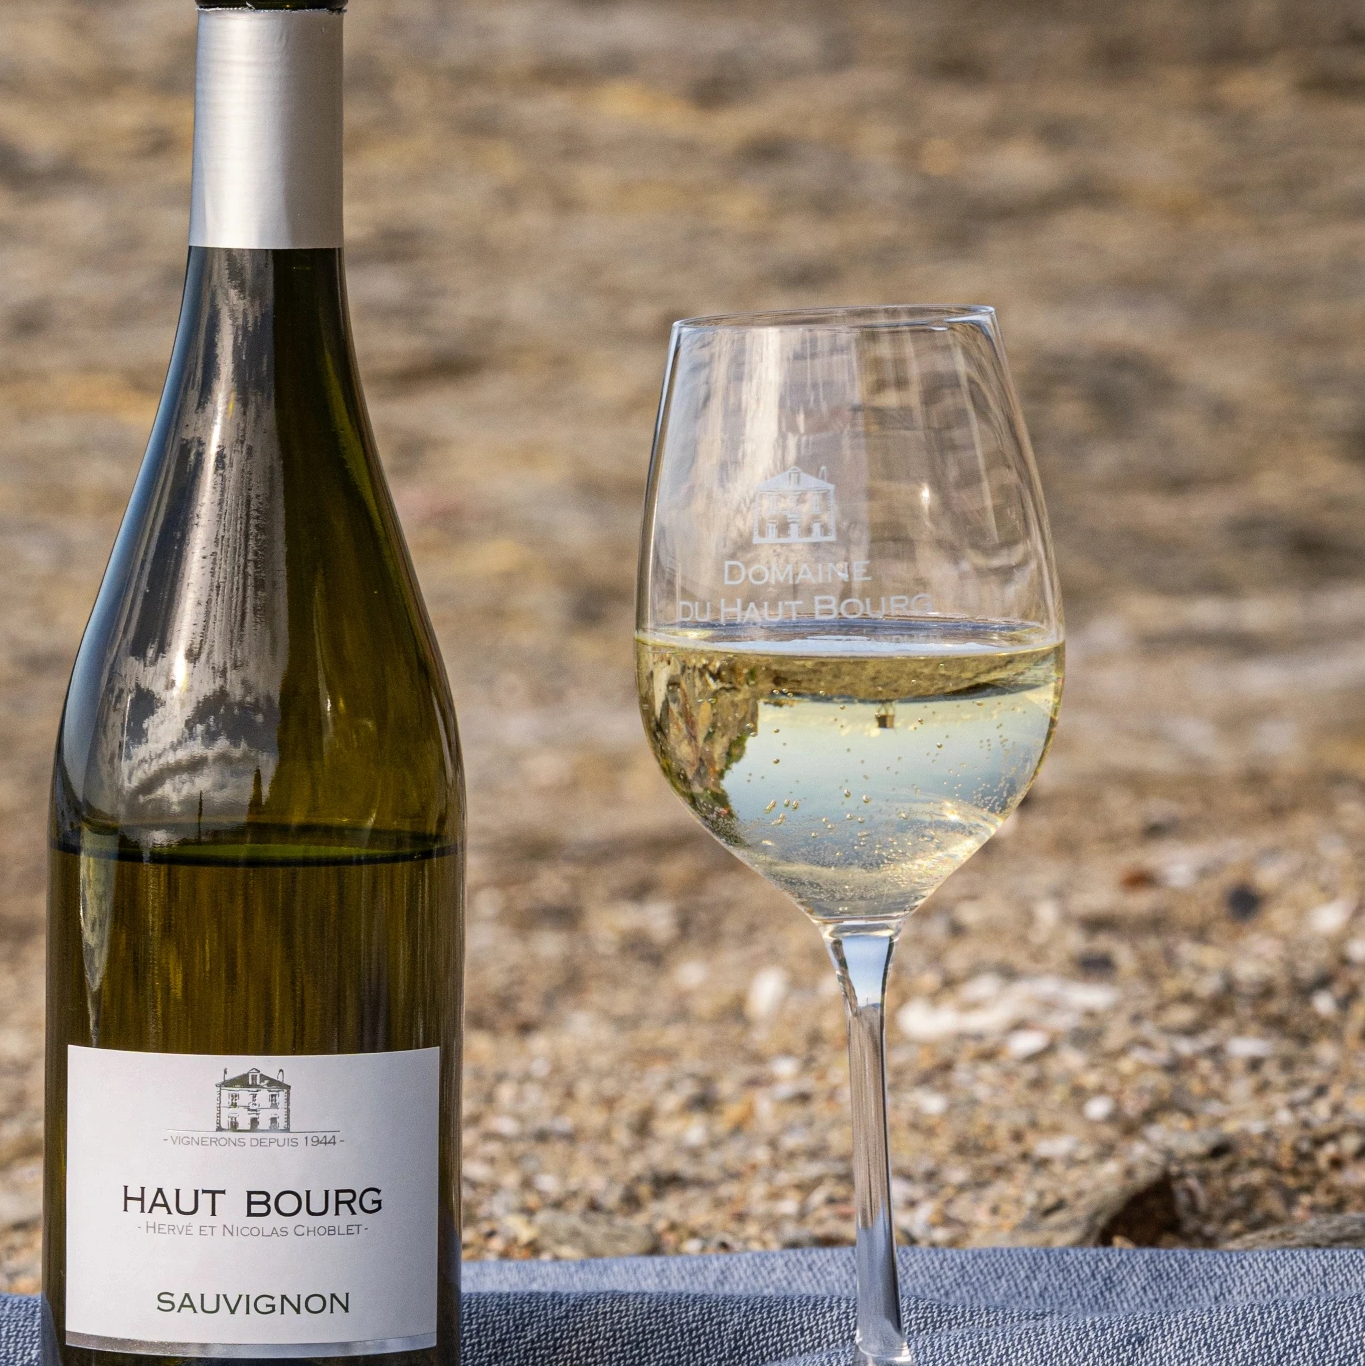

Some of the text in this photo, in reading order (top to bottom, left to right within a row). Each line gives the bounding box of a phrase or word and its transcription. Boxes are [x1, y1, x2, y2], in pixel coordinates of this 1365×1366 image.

[723, 560, 872, 585] DOMAINE
[678, 593, 933, 623] DU HAUT BOURG
[170, 1135, 337, 1147] VIGNERONS DEPUIS 1944
[122, 1185, 383, 1218] HAUT BOURG
[145, 1221, 363, 1237] HERVÉ ET NICOLAS CHOBLET
[156, 1291, 350, 1315] SAUVIGNON
